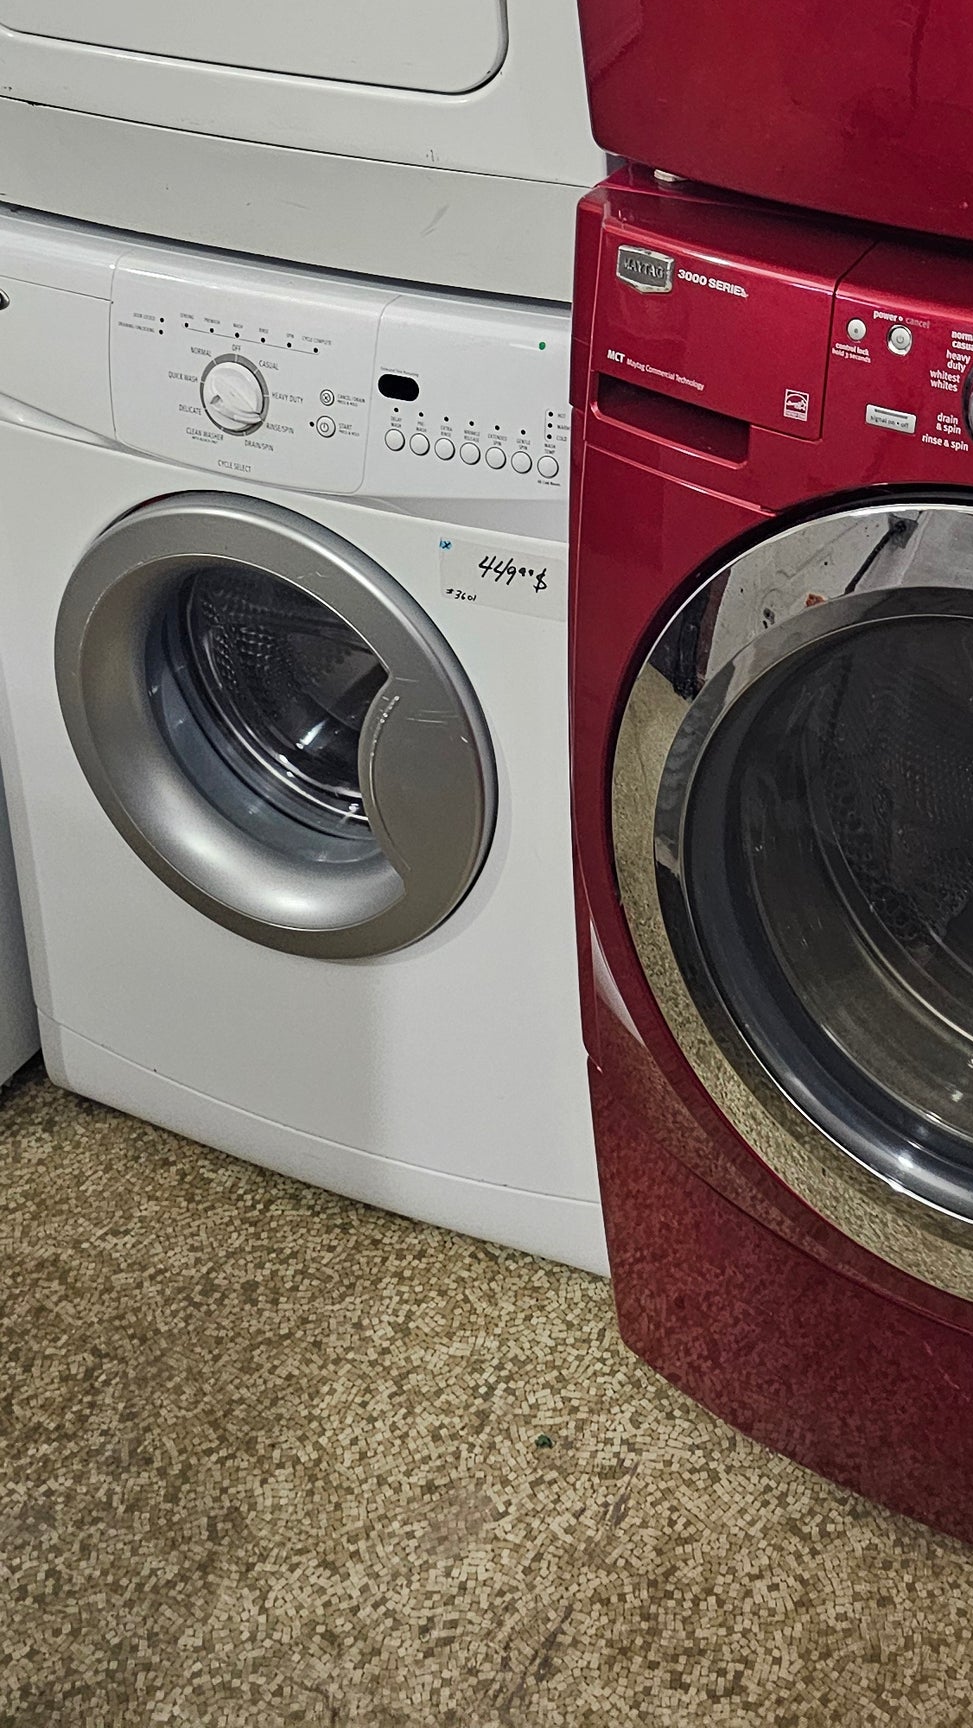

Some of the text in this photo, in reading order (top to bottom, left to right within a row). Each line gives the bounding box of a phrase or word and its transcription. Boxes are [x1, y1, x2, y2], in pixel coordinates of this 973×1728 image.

[624, 257, 665, 278] MAYTAG
[678, 269, 708, 286] 3000
[874, 310, 930, 329] power cancel
[232, 344, 241, 352] OFF
[836, 342, 870, 356] control lock
[946, 349, 970, 364] heavy
[258, 360, 280, 371] CASUAL
[607, 350, 705, 392] MCT Maytag Commercial Technology
[946, 360, 966, 373] duty
[168, 370, 198, 382] QUICK WASH
[930, 370, 960, 384] whitest
[930, 379, 958, 392] whites
[272, 392, 304, 404] HEAVY DUTY
[178, 404, 202, 416] DELICATE
[938, 412, 958, 424] drain
[943, 424, 962, 435] spin
[922, 433, 942, 446] rinse
[950, 440, 969, 452] spin
[218, 459, 252, 473] CYCLE SELECT
